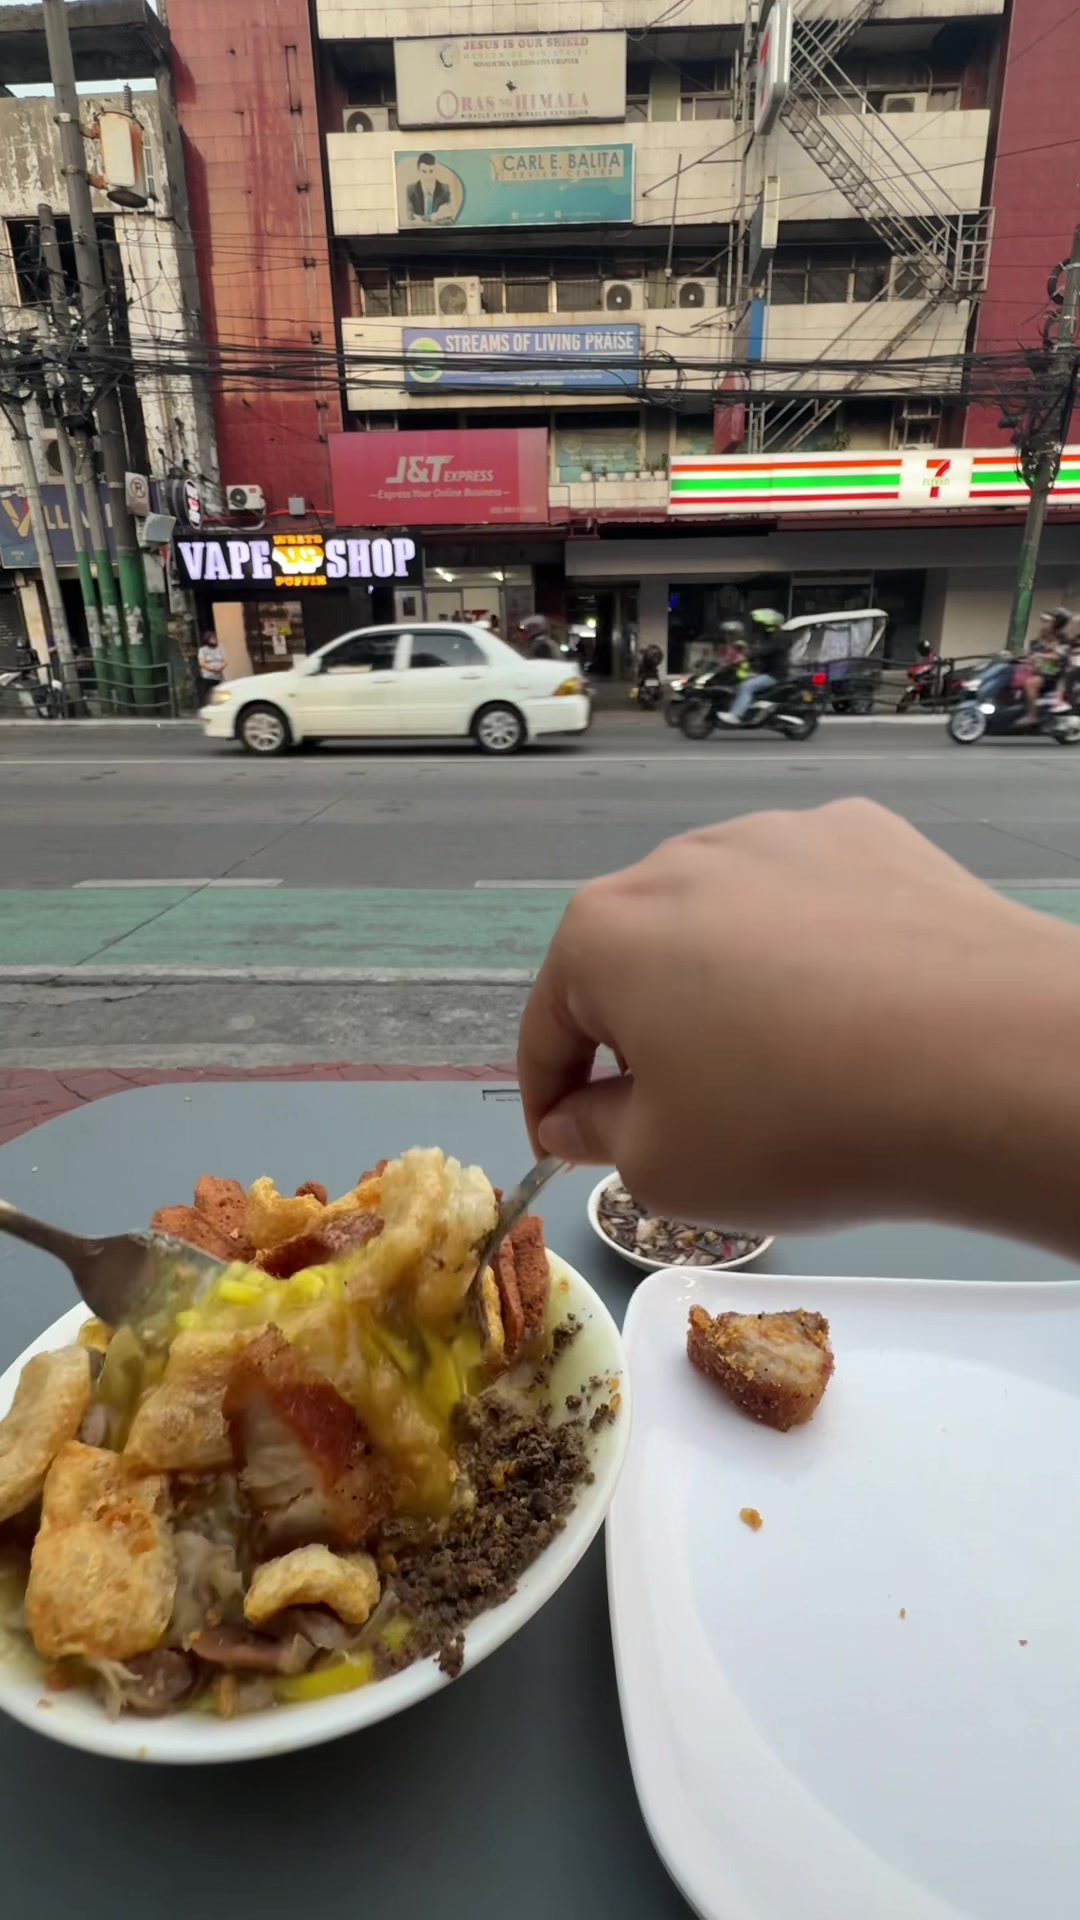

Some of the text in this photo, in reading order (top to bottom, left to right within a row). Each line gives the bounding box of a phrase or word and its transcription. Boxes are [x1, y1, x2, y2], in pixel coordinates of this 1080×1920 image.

[464, 37, 589, 50] JESUS IS OUR SHIELD
[515, 93, 589, 111] HIMALA
[503, 151, 620, 171] CARL E. BALITA
[445, 331, 635, 353] STREAMS OF LIVING PRAISE
[385, 455, 494, 484] J&T EXPRESS
[926, 459, 951, 498] 7
[377, 487, 502, 501] Express Your Online Business
[272, 535, 323, 545] WHATS
[178, 537, 416, 581] VAPE SHOP
